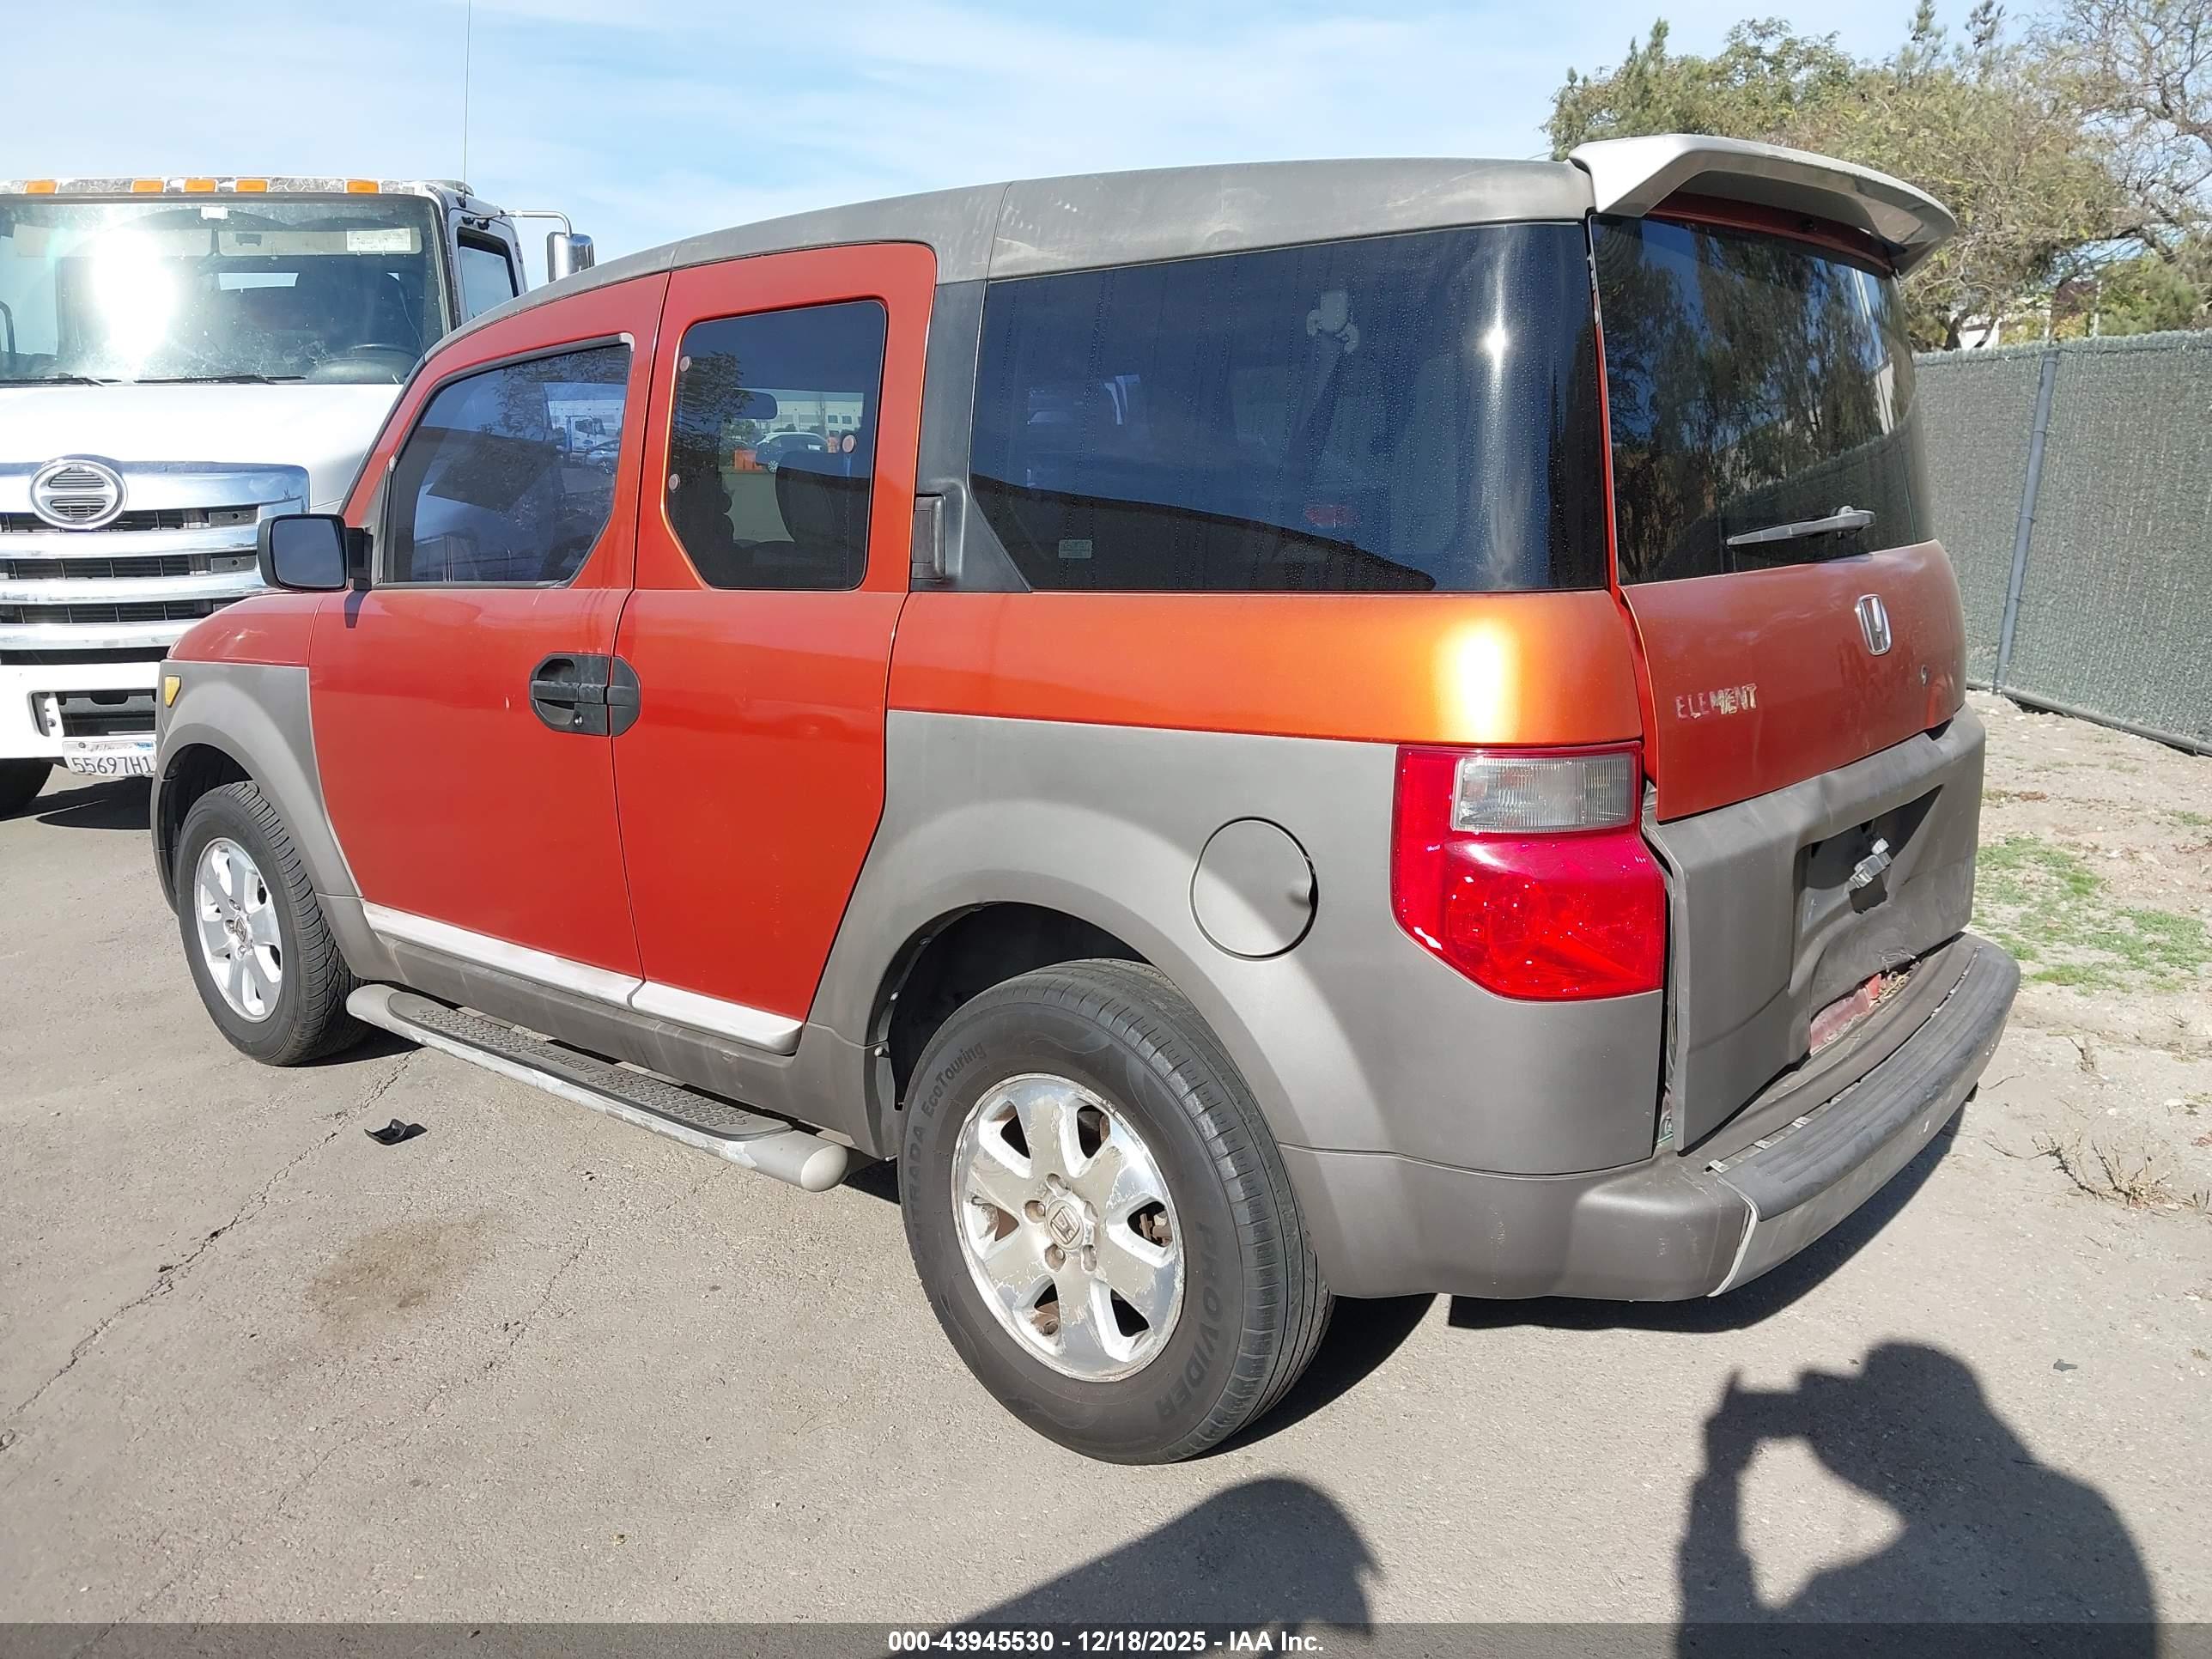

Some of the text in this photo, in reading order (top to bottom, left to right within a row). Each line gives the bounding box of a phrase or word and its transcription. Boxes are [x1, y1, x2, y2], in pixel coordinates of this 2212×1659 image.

[1675, 683, 1757, 719] ELEMENT
[70, 756, 153, 775] 55697H1
[921, 1042, 987, 1117] EcoTouring
